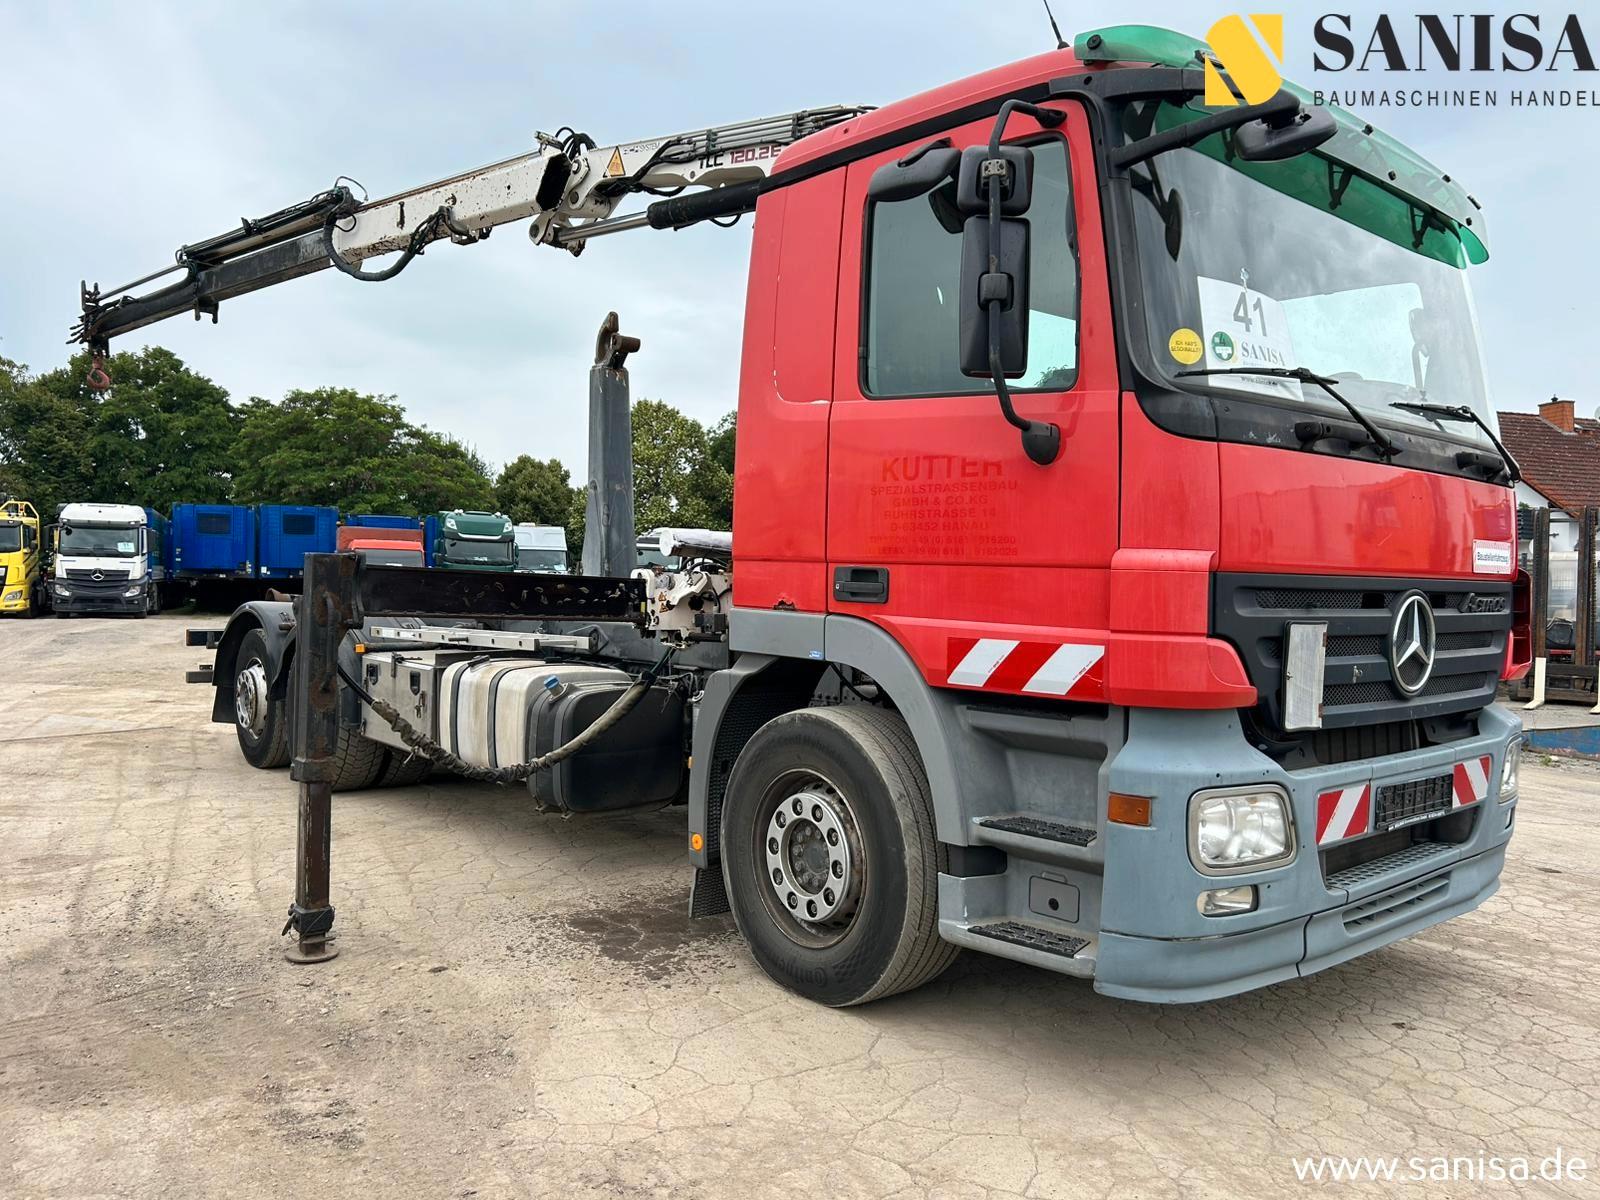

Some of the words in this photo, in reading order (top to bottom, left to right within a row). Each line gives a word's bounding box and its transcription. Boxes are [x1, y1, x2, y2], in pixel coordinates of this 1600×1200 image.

[729, 145, 782, 164] 120.2E
[1233, 291, 1267, 337] 41
[1241, 341, 1286, 367] SANISA
[882, 455, 1004, 482] KUTTER
[870, 480, 1018, 496] SPEZIALSTRASSENBAU
[892, 496, 929, 507] GMBH
[933, 496, 941, 506] &
